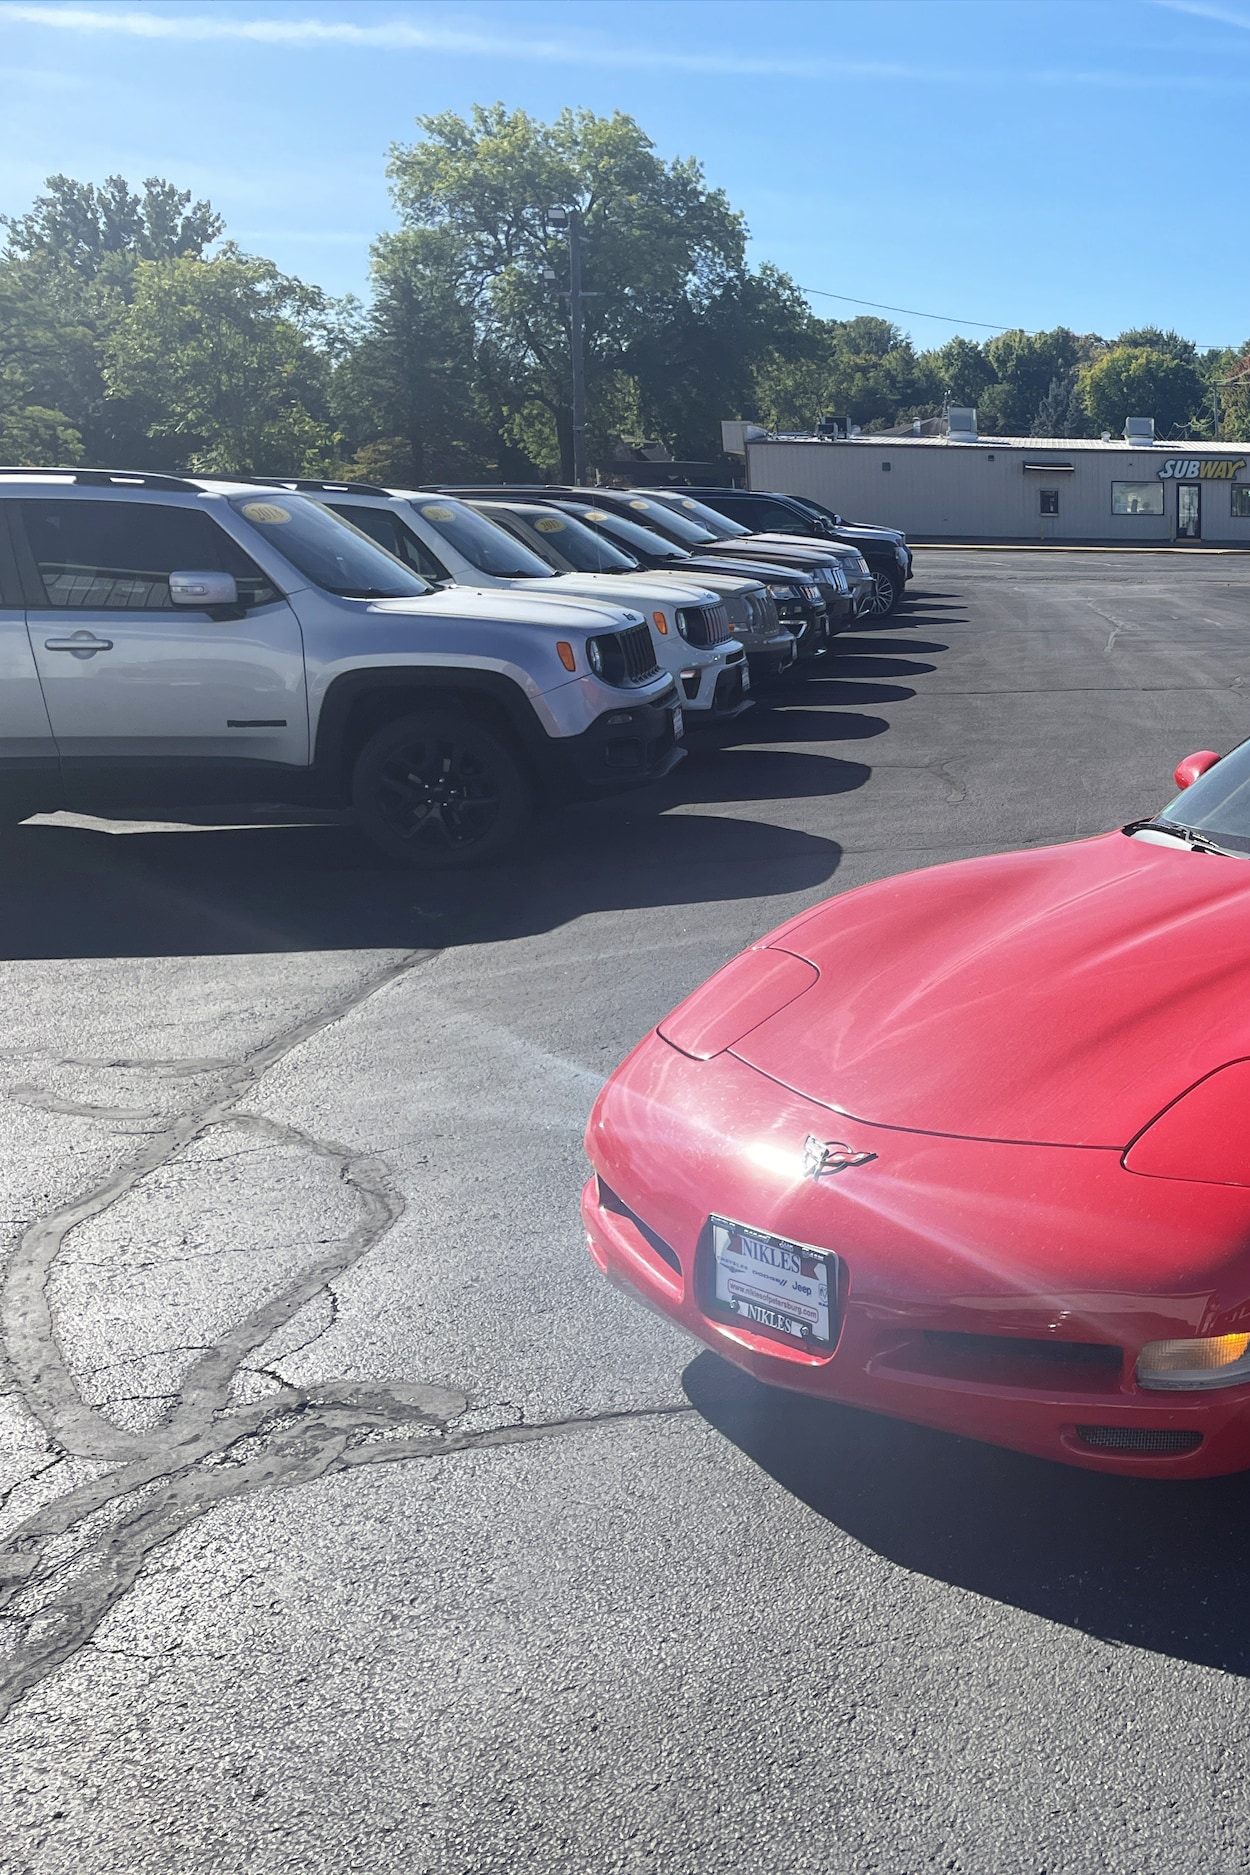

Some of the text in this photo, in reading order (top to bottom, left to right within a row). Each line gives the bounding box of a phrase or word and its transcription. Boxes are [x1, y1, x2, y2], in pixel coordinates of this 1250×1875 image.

[1158, 460, 1246, 479] SUBWAY
[742, 1237, 800, 1274] NIKLES
[792, 1280, 812, 1296] Jeep
[748, 1303, 792, 1334] NIKLES
